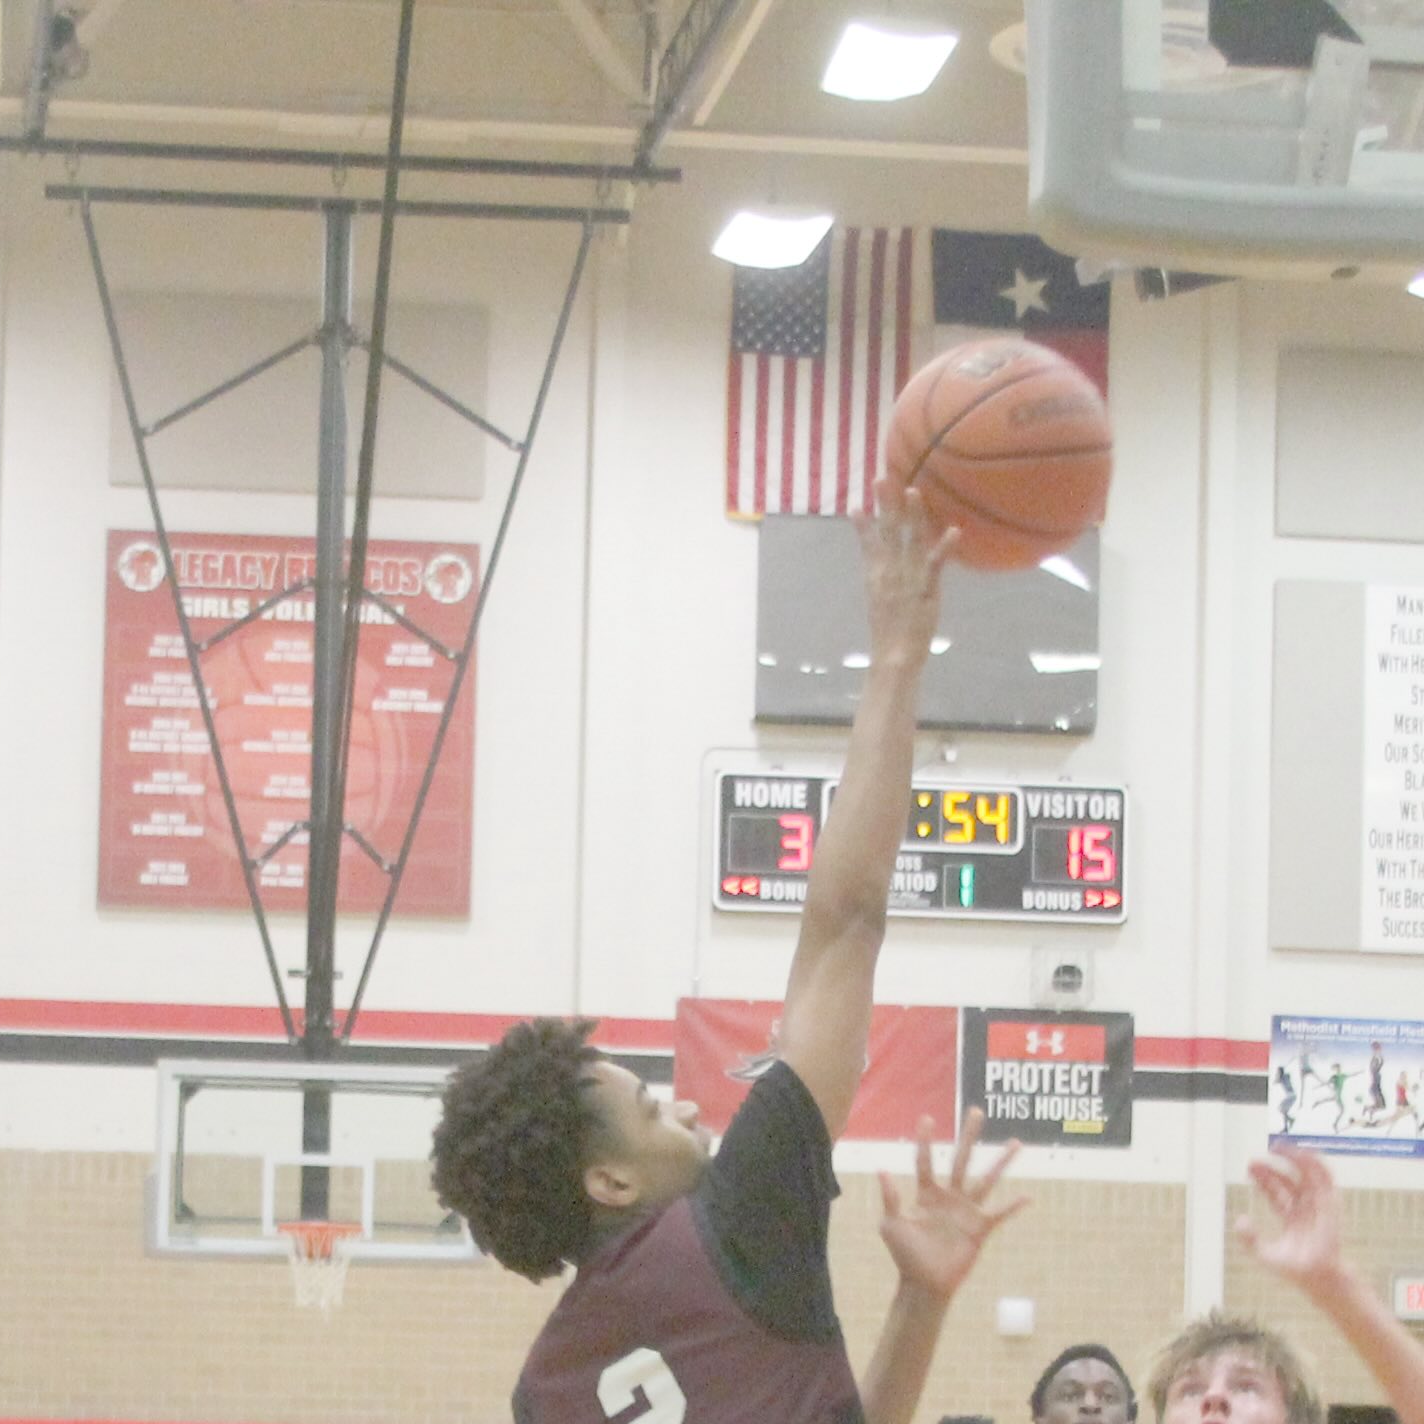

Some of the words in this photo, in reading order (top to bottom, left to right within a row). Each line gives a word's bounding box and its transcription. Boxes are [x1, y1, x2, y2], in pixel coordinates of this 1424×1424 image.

[173, 550, 280, 590] LEGACY
[1378, 652, 1408, 673] WITH
[1384, 742, 1408, 764] OUR
[734, 782, 807, 809] HOME
[1027, 793, 1121, 821] VISITOR
[1400, 801, 1418, 822] WE
[1369, 829, 1393, 849] OUR
[896, 856, 922, 871] OSS
[1067, 825, 1116, 883] 15
[1376, 858, 1406, 880] WITH
[760, 880, 807, 902] BONU
[889, 872, 937, 892] RIOD
[959, 864, 975, 908] 1
[1022, 890, 1082, 912] BONUS
[1379, 888, 1401, 908] THE
[1281, 1021, 1339, 1035] Methodist
[1341, 1024, 1396, 1036] Mansfield
[985, 1061, 1102, 1096] PROTECT
[986, 1094, 1030, 1119] THIS
[1034, 1096, 1109, 1122] HOUSE.
